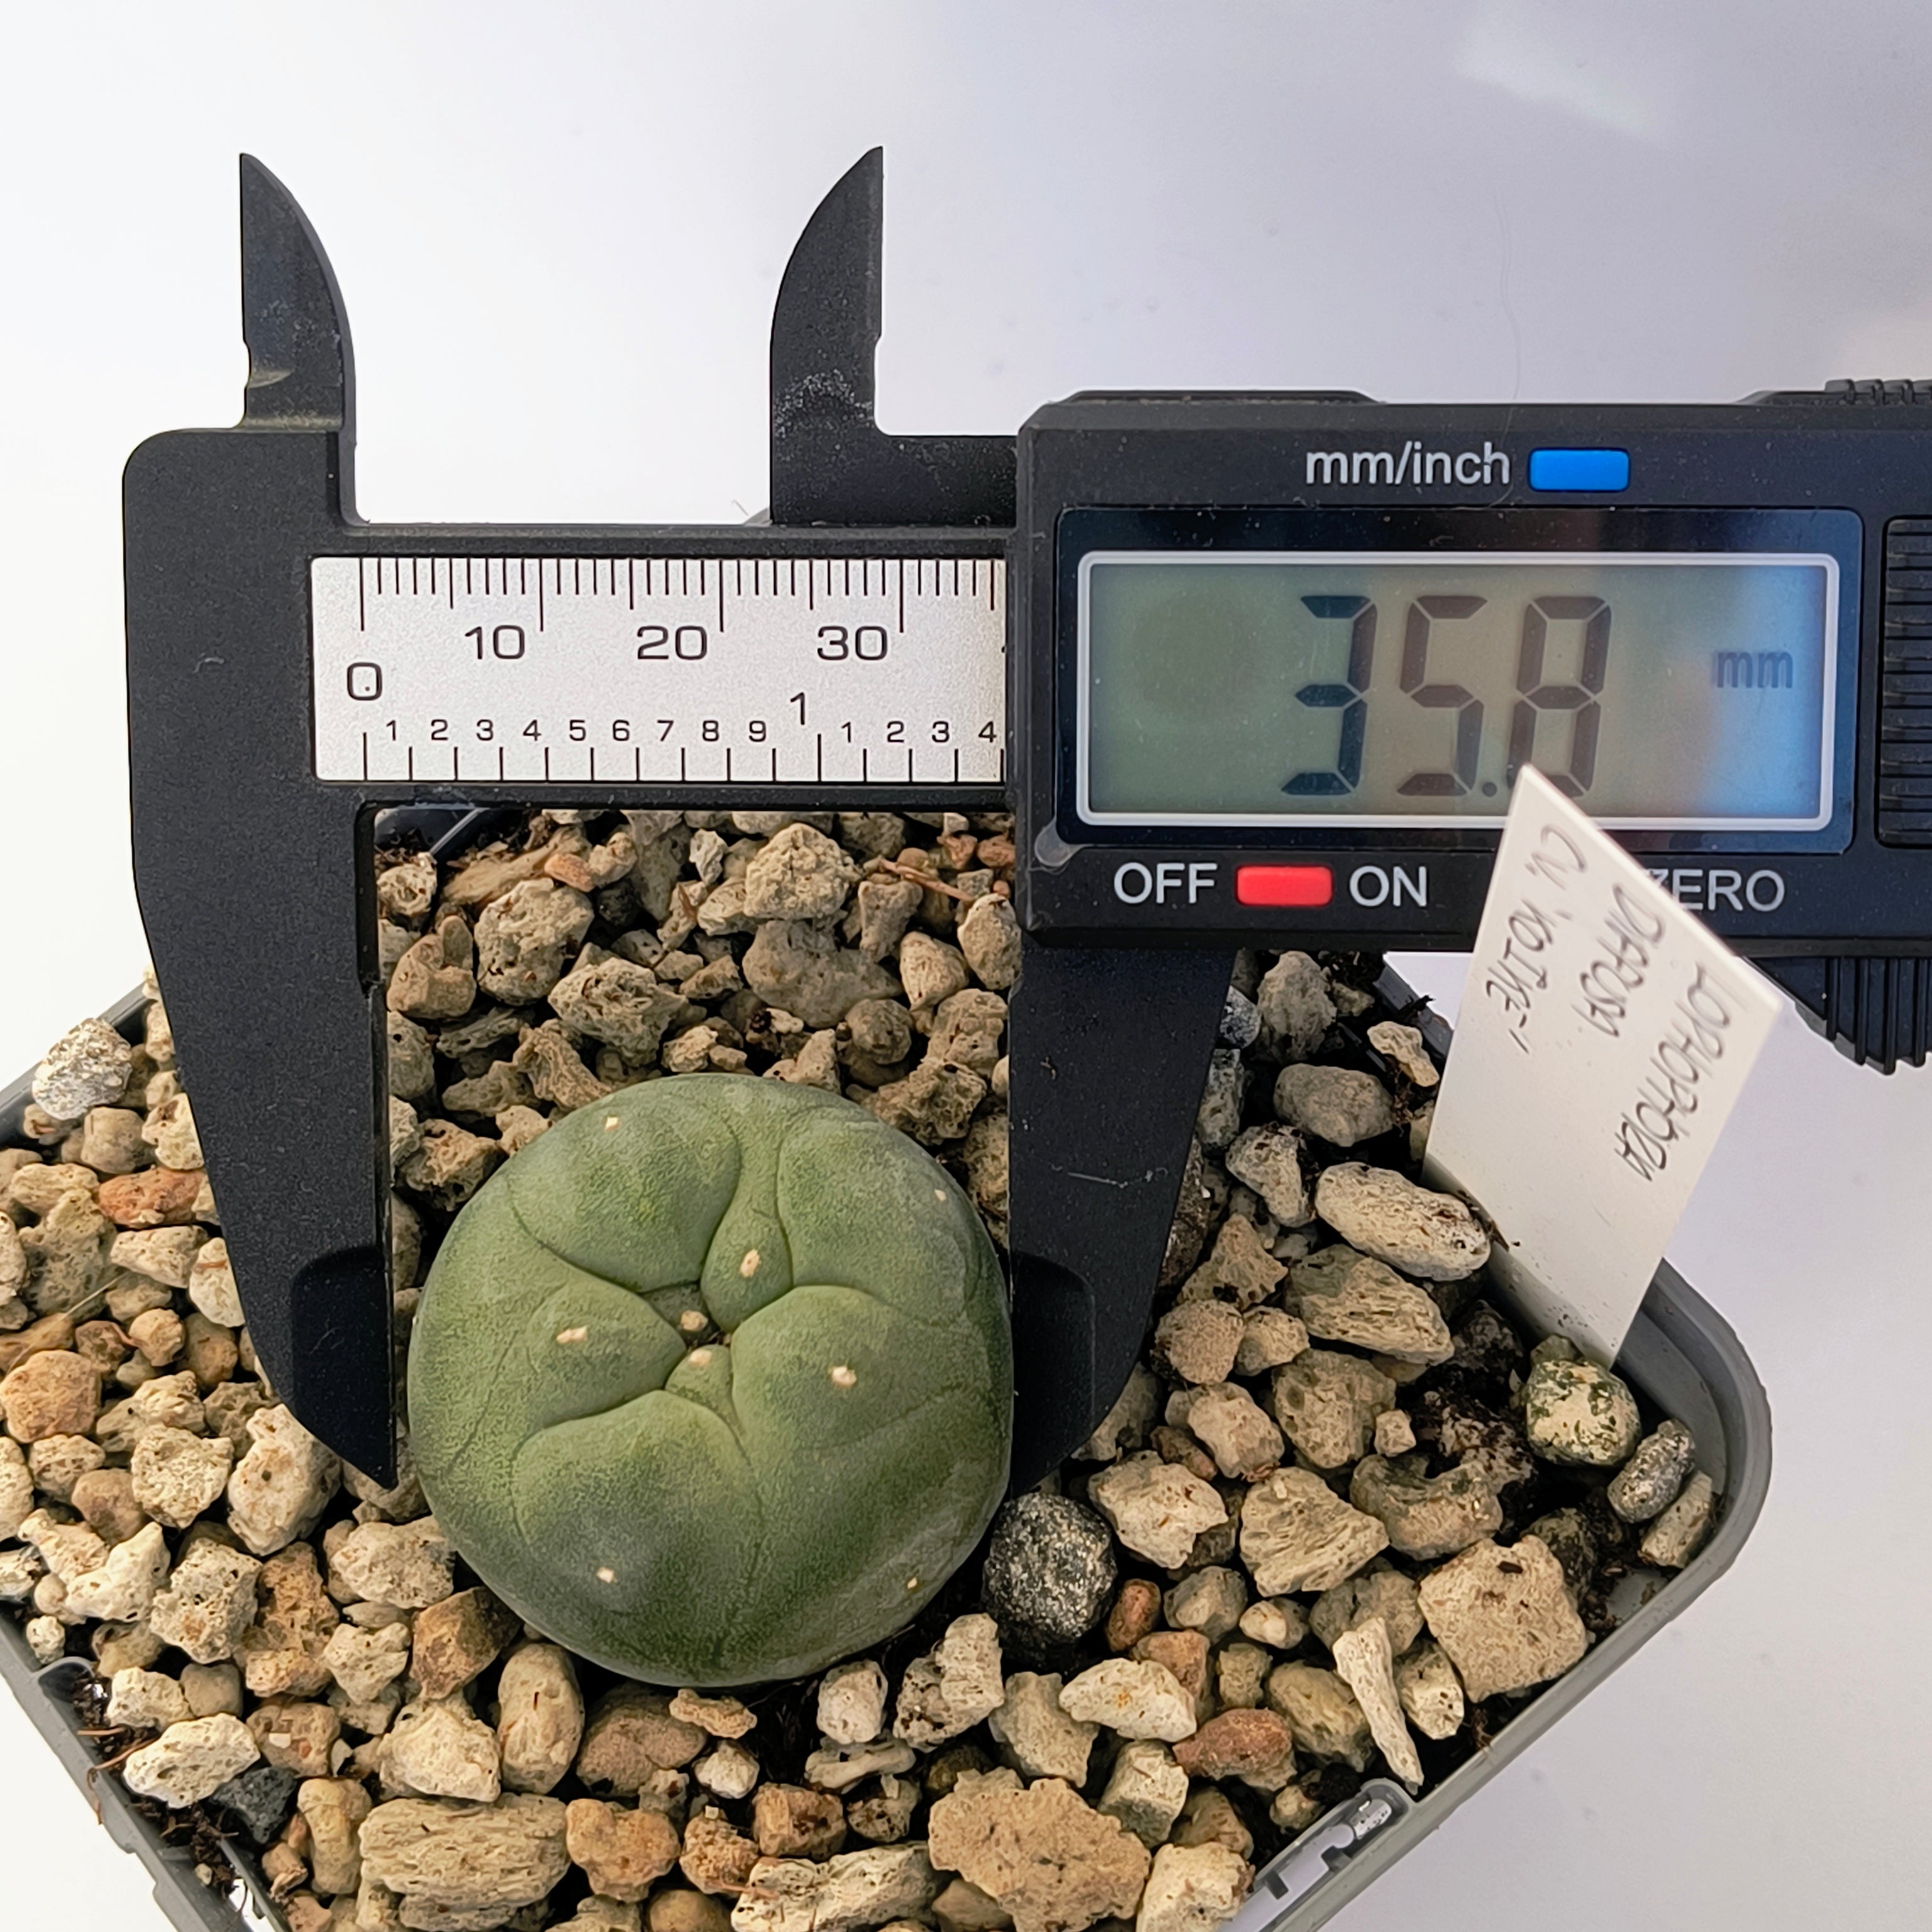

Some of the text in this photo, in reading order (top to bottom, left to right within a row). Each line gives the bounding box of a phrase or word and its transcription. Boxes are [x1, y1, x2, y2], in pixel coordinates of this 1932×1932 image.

[1306, 440, 1510, 485] mm/inch
[464, 625, 888, 662] 10 20 30
[347, 662, 383, 702] 0
[1280, 595, 1794, 798] 35.8 mm
[789, 692, 806, 726] 1
[386, 719, 998, 744] 1 2 3 4 5 6 7 8 9 1 2 3 4
[1113, 862, 1218, 904] OFF
[1349, 865, 1428, 907] ON
